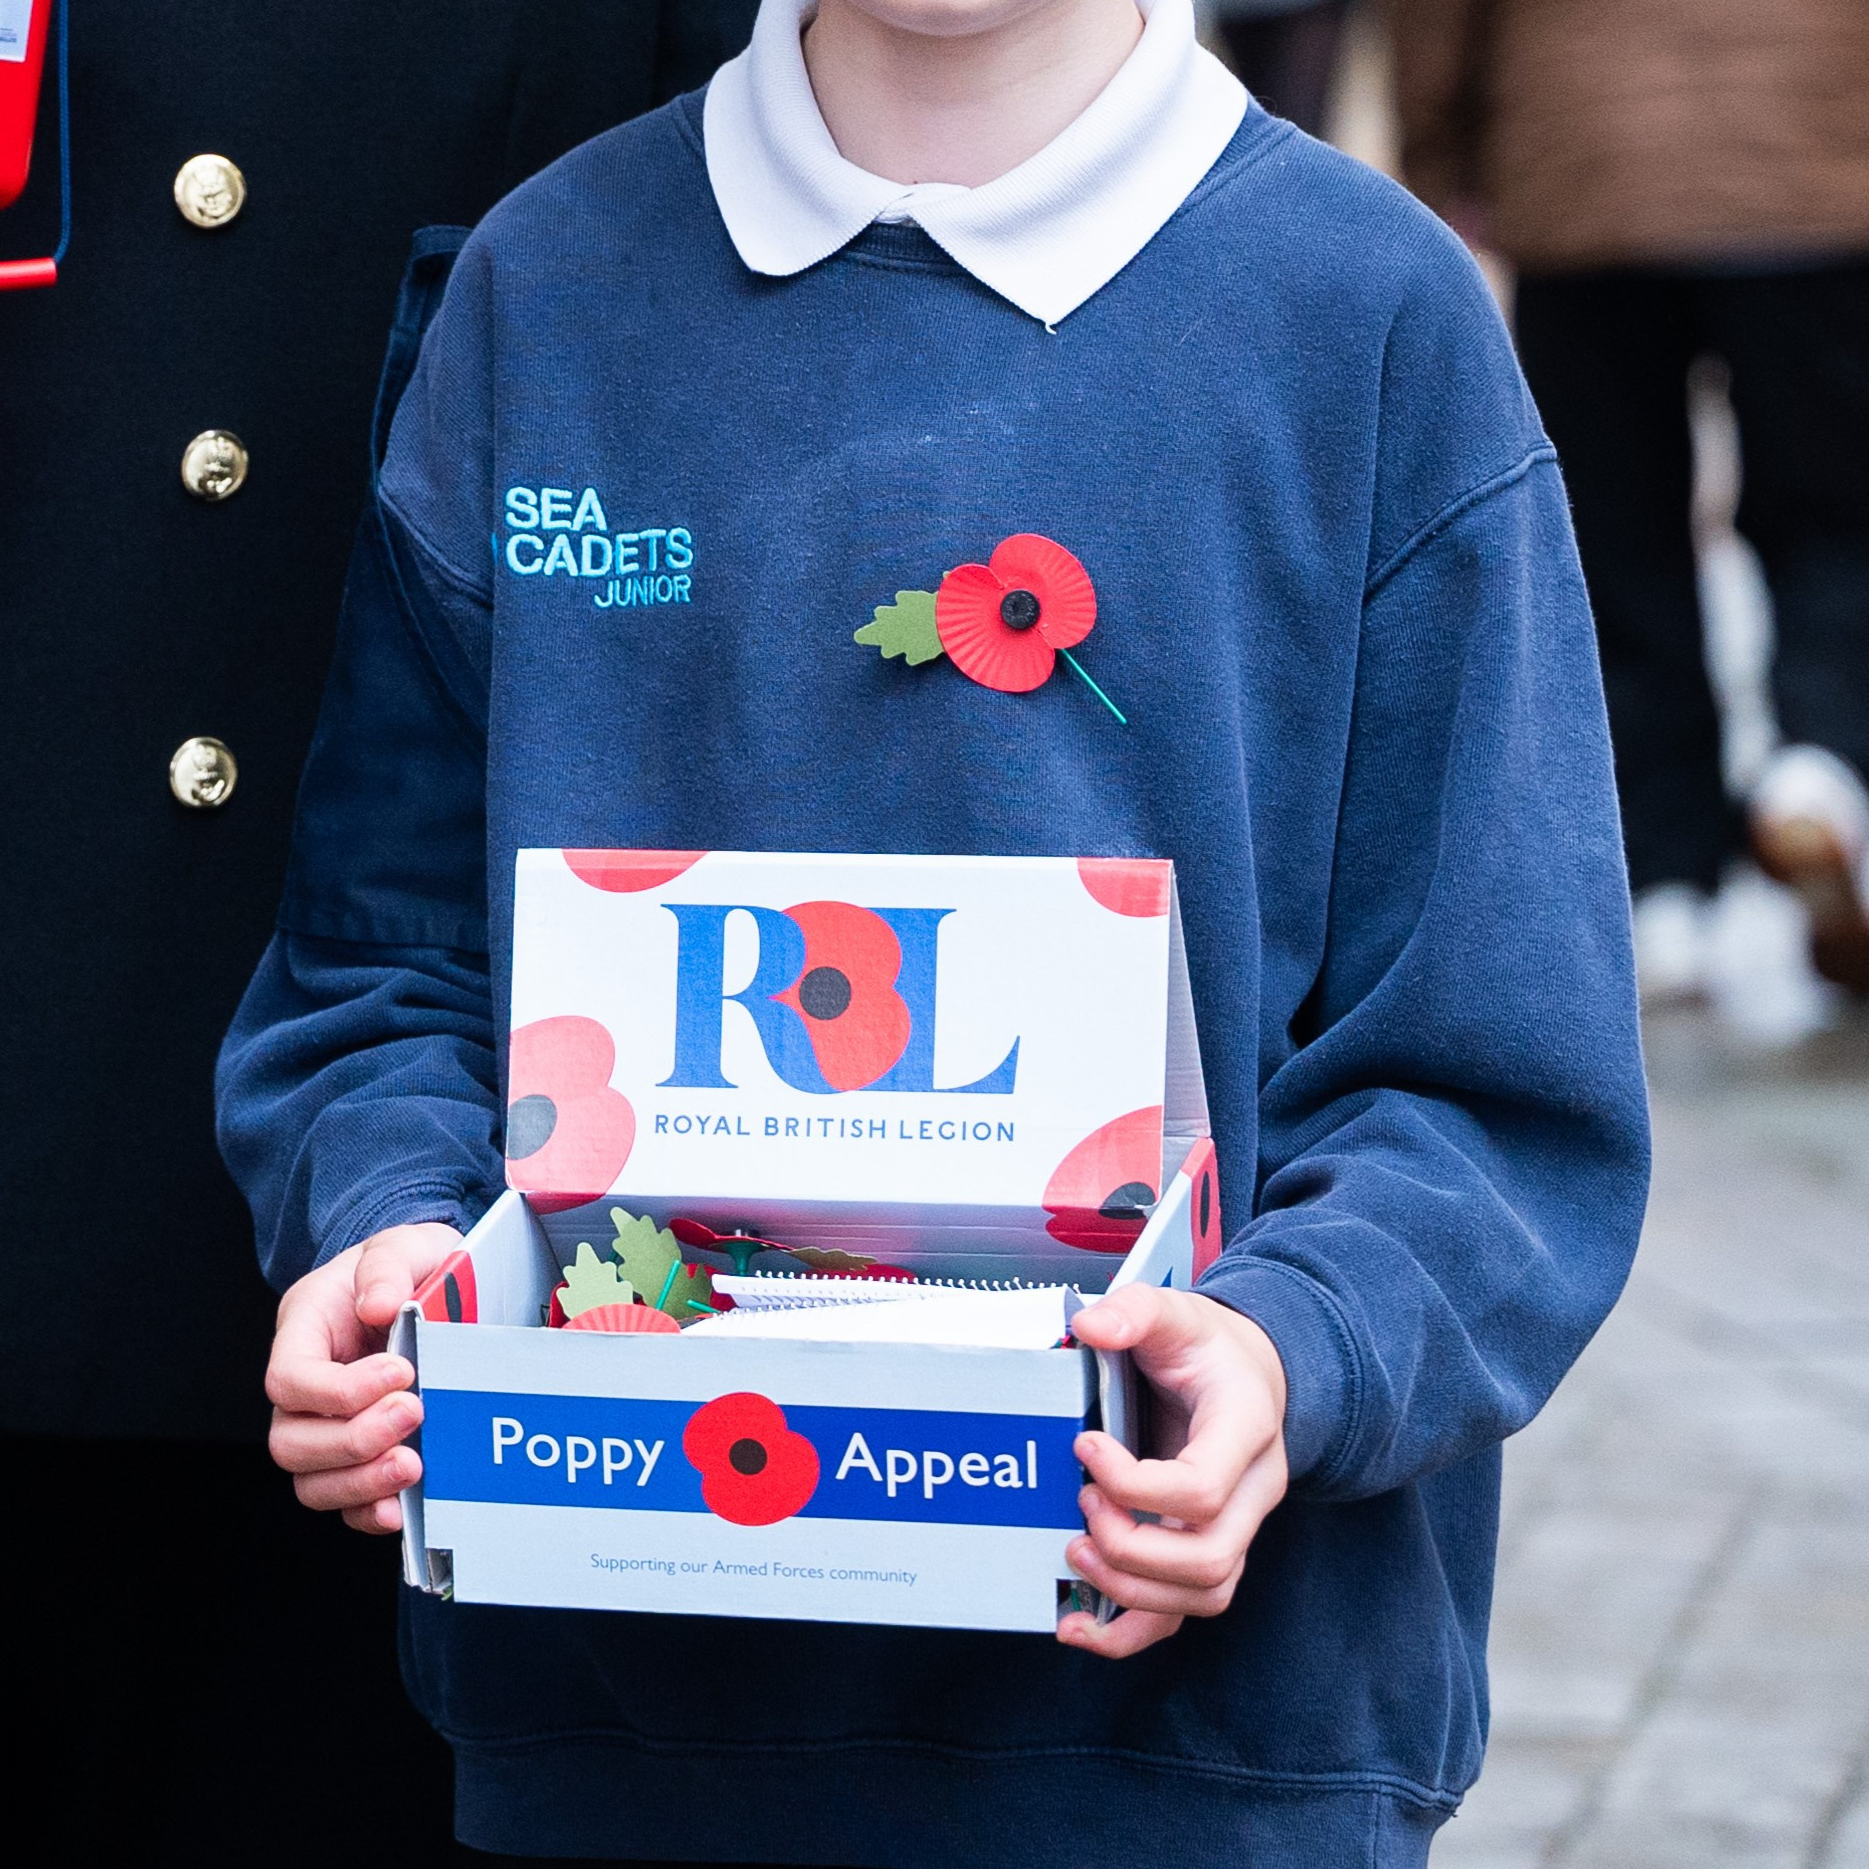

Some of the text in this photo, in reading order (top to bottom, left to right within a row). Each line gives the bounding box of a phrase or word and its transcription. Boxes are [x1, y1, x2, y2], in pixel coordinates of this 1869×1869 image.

[505, 486, 608, 532] SEA
[505, 527, 694, 576] CADETS
[593, 574, 693, 608] JUNIOR
[655, 1114, 1015, 1142] ROYAL BRITISH LEGION
[492, 1416, 1038, 1500] Poppy Appeal
[590, 1553, 919, 1588] Supporting our Armed Forces community
